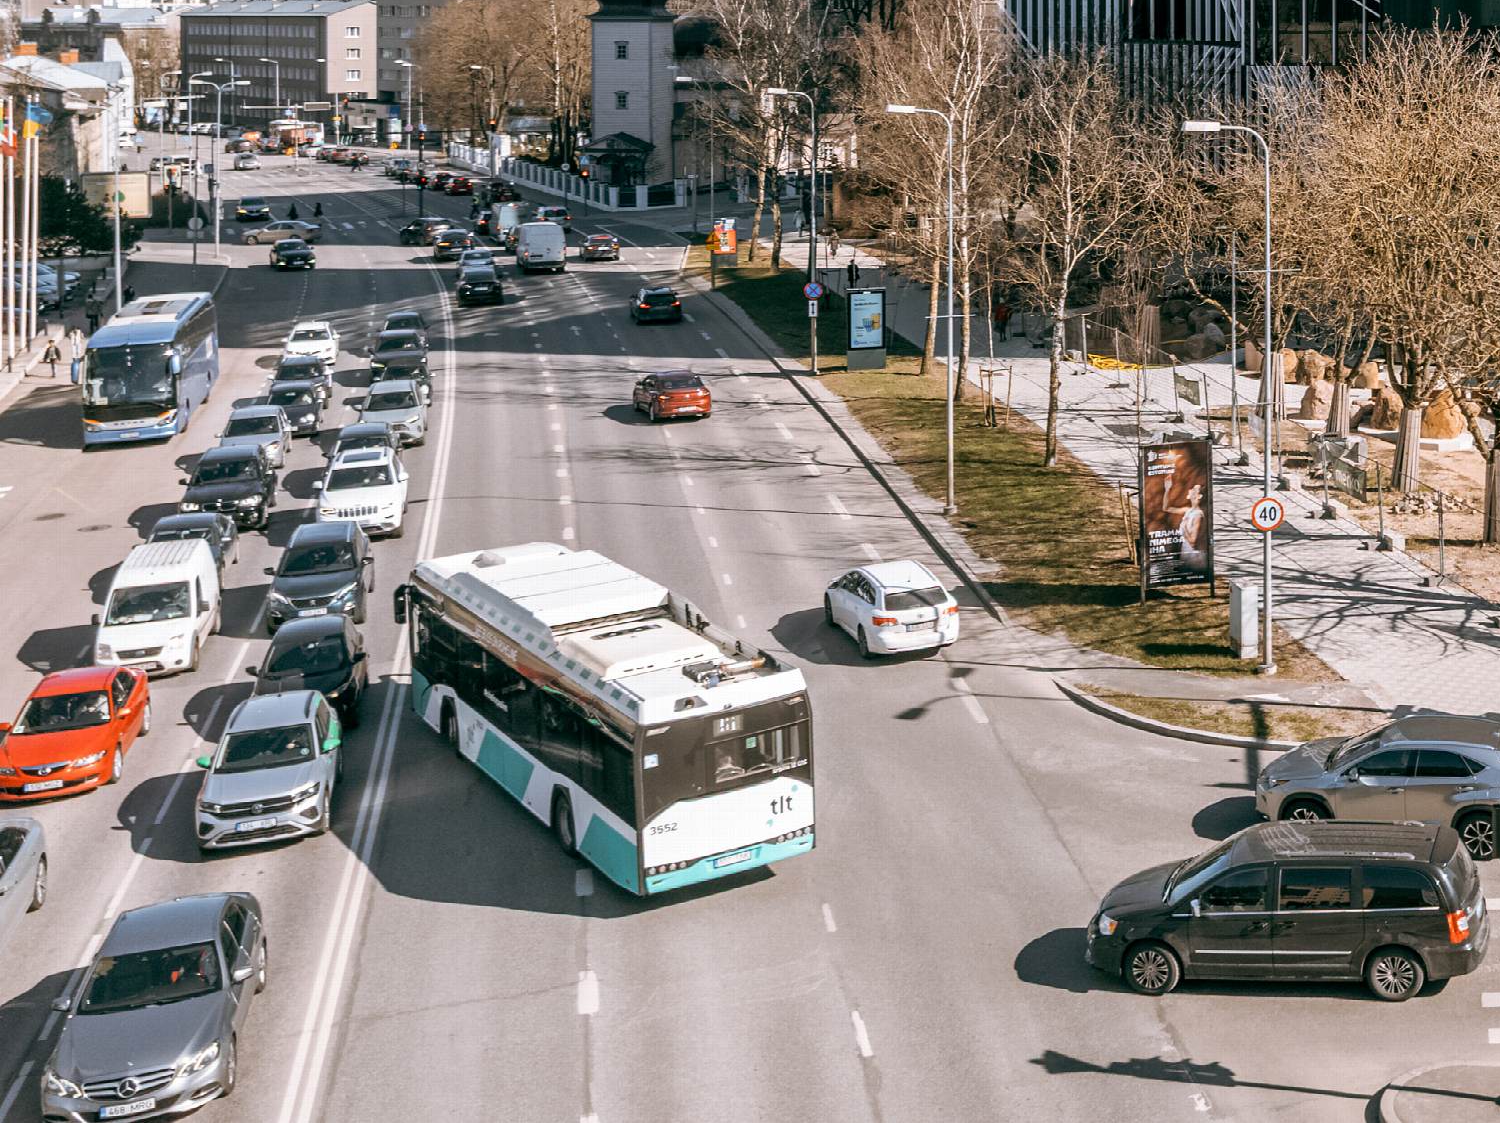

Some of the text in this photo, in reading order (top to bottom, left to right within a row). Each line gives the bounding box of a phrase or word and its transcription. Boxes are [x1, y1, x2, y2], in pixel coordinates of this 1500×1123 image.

[1259, 506, 1277, 522] 40
[770, 795, 794, 815] tlt
[649, 822, 679, 836] 3552
